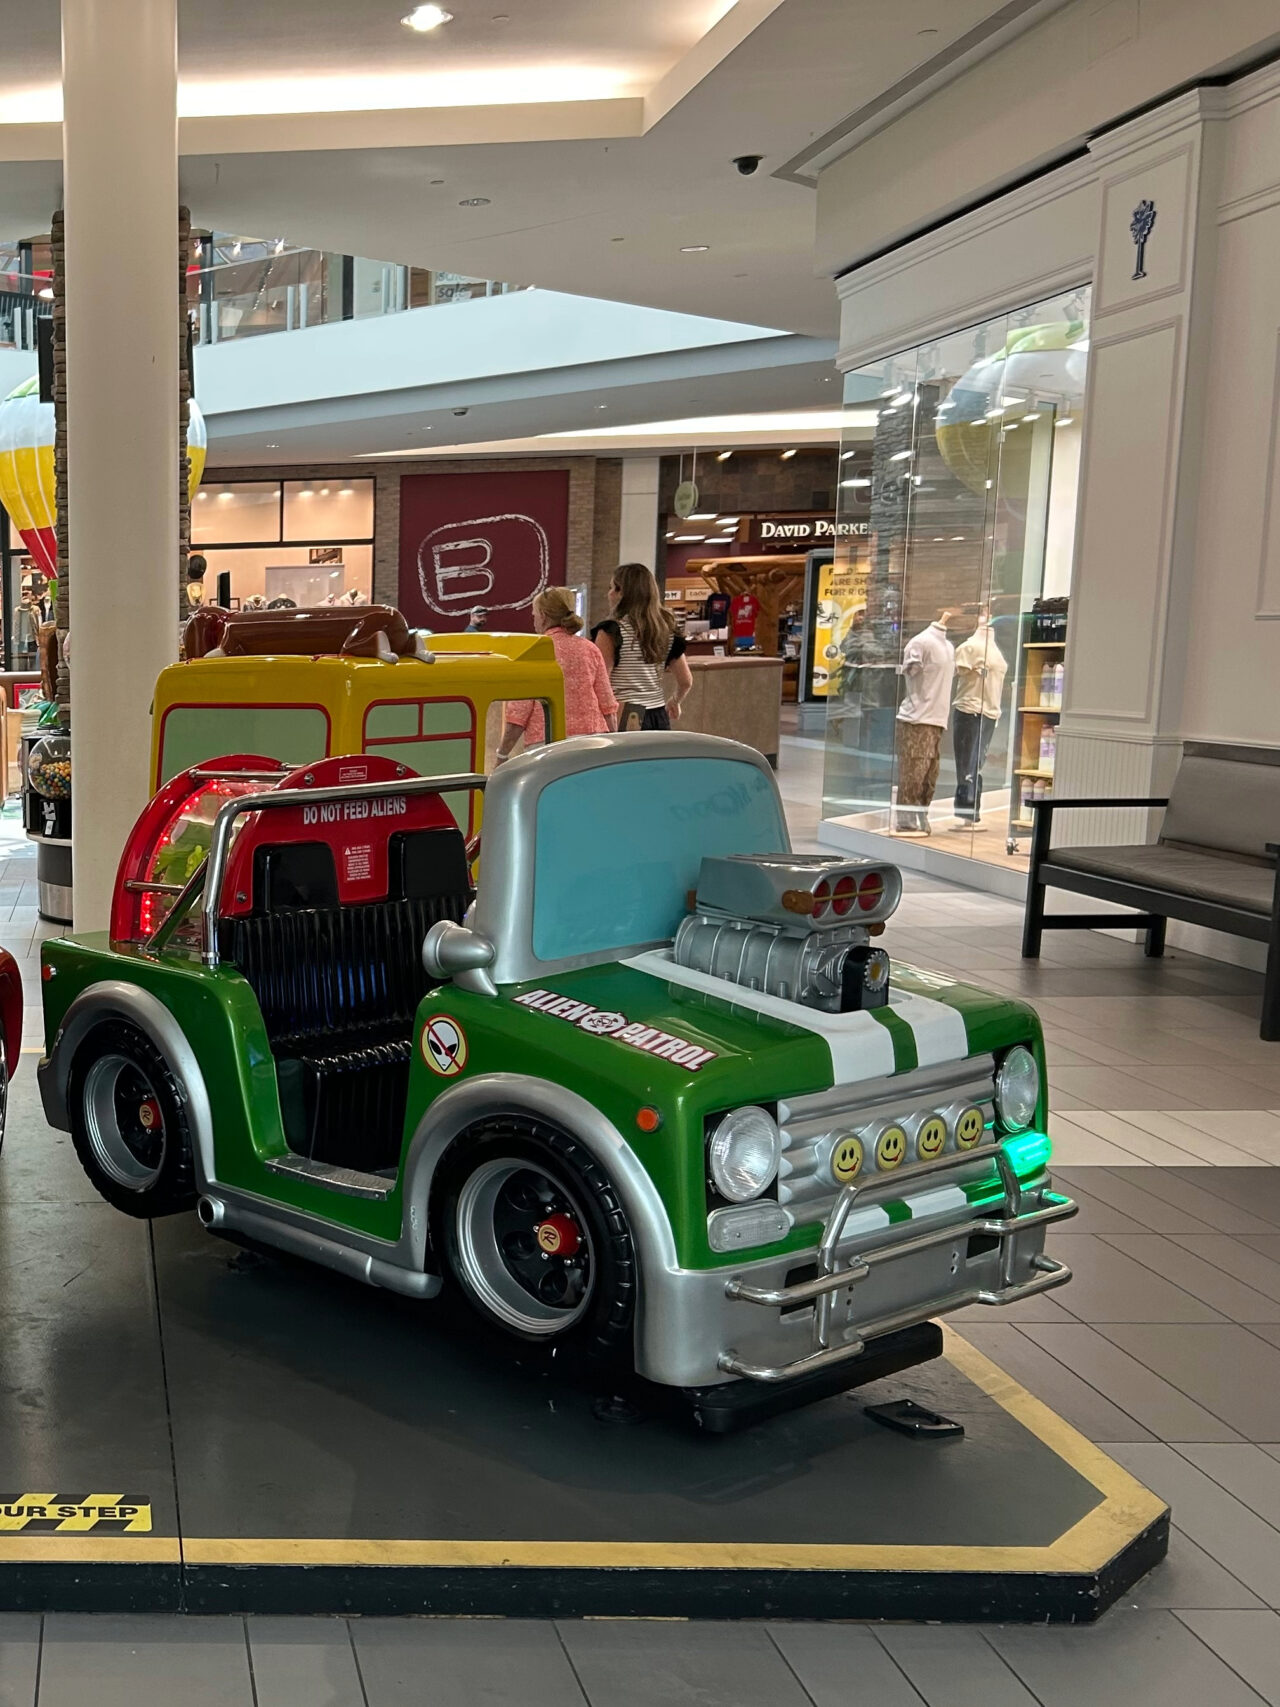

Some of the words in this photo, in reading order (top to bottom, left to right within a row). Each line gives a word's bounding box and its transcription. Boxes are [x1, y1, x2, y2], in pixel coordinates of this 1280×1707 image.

[761, 522, 810, 538] DAVID
[814, 520, 871, 536] PARKE
[432, 537, 494, 601] B
[303, 806, 318, 825] DO
[320, 804, 341, 823] NOT
[344, 801, 369, 820] FEED
[370, 796, 407, 817] ALIENS
[512, 989, 596, 1022] ALIEN
[611, 1021, 719, 1072] PATROL
[56, 1505, 139, 1518] STEP
